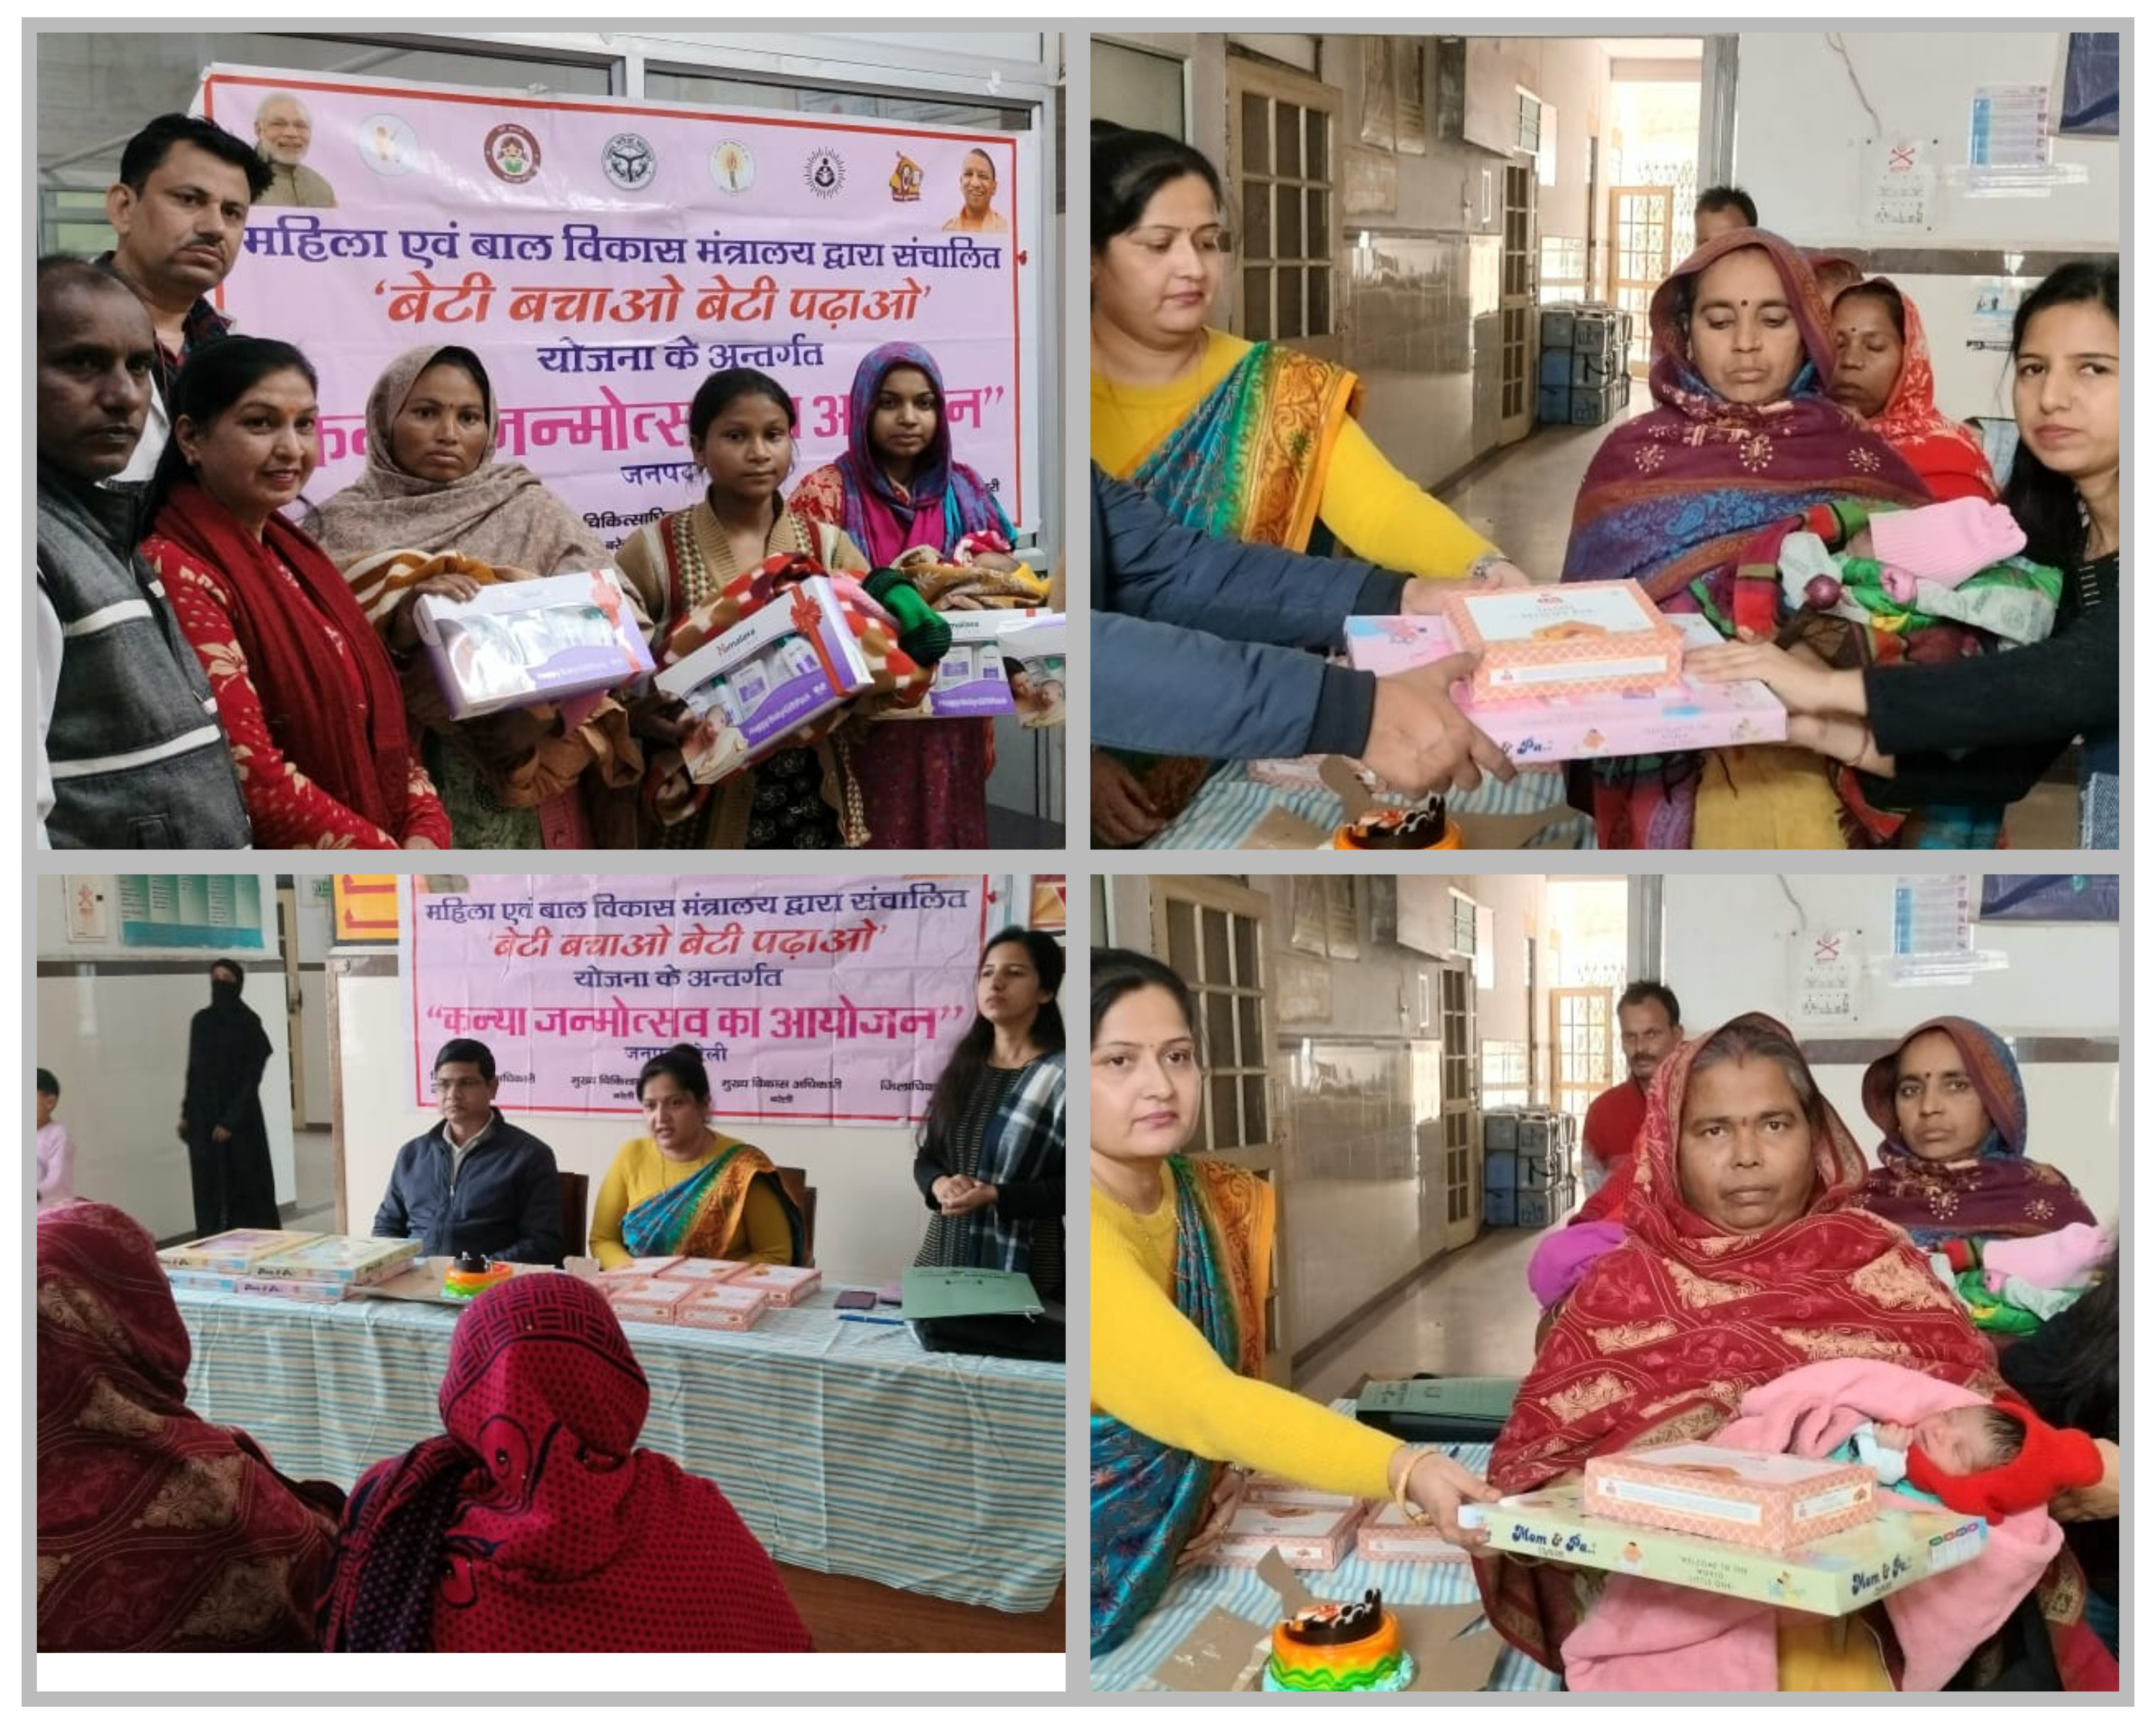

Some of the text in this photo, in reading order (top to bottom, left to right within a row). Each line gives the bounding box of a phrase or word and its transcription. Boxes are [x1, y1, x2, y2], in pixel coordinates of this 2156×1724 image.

[243, 215, 1002, 269] महिला एवं बाल विकास मंत्रालय द्वारा संचालित
[508, 273, 685, 323] बचाओ
[696, 274, 779, 322] बेटी
[537, 333, 824, 373] योजना के अन्तर्गत
[426, 883, 970, 925] महिला एवं बाल विकास मंत्रालय द्वारा संचालित
[560, 925, 673, 957] बचाओ
[679, 923, 744, 955] बेटी
[574, 963, 783, 988] योजना के अन्तर्गत
[534, 995, 710, 1038] जन्मोत्सव
[717, 1007, 761, 1038] का
[721, 1079, 748, 1092] मुख्य
[752, 1076, 789, 1089] विकास
[1512, 1524, 1548, 1545] Mom
[1551, 1532, 1564, 1546] &
[1852, 1572, 1880, 1595] Mom
